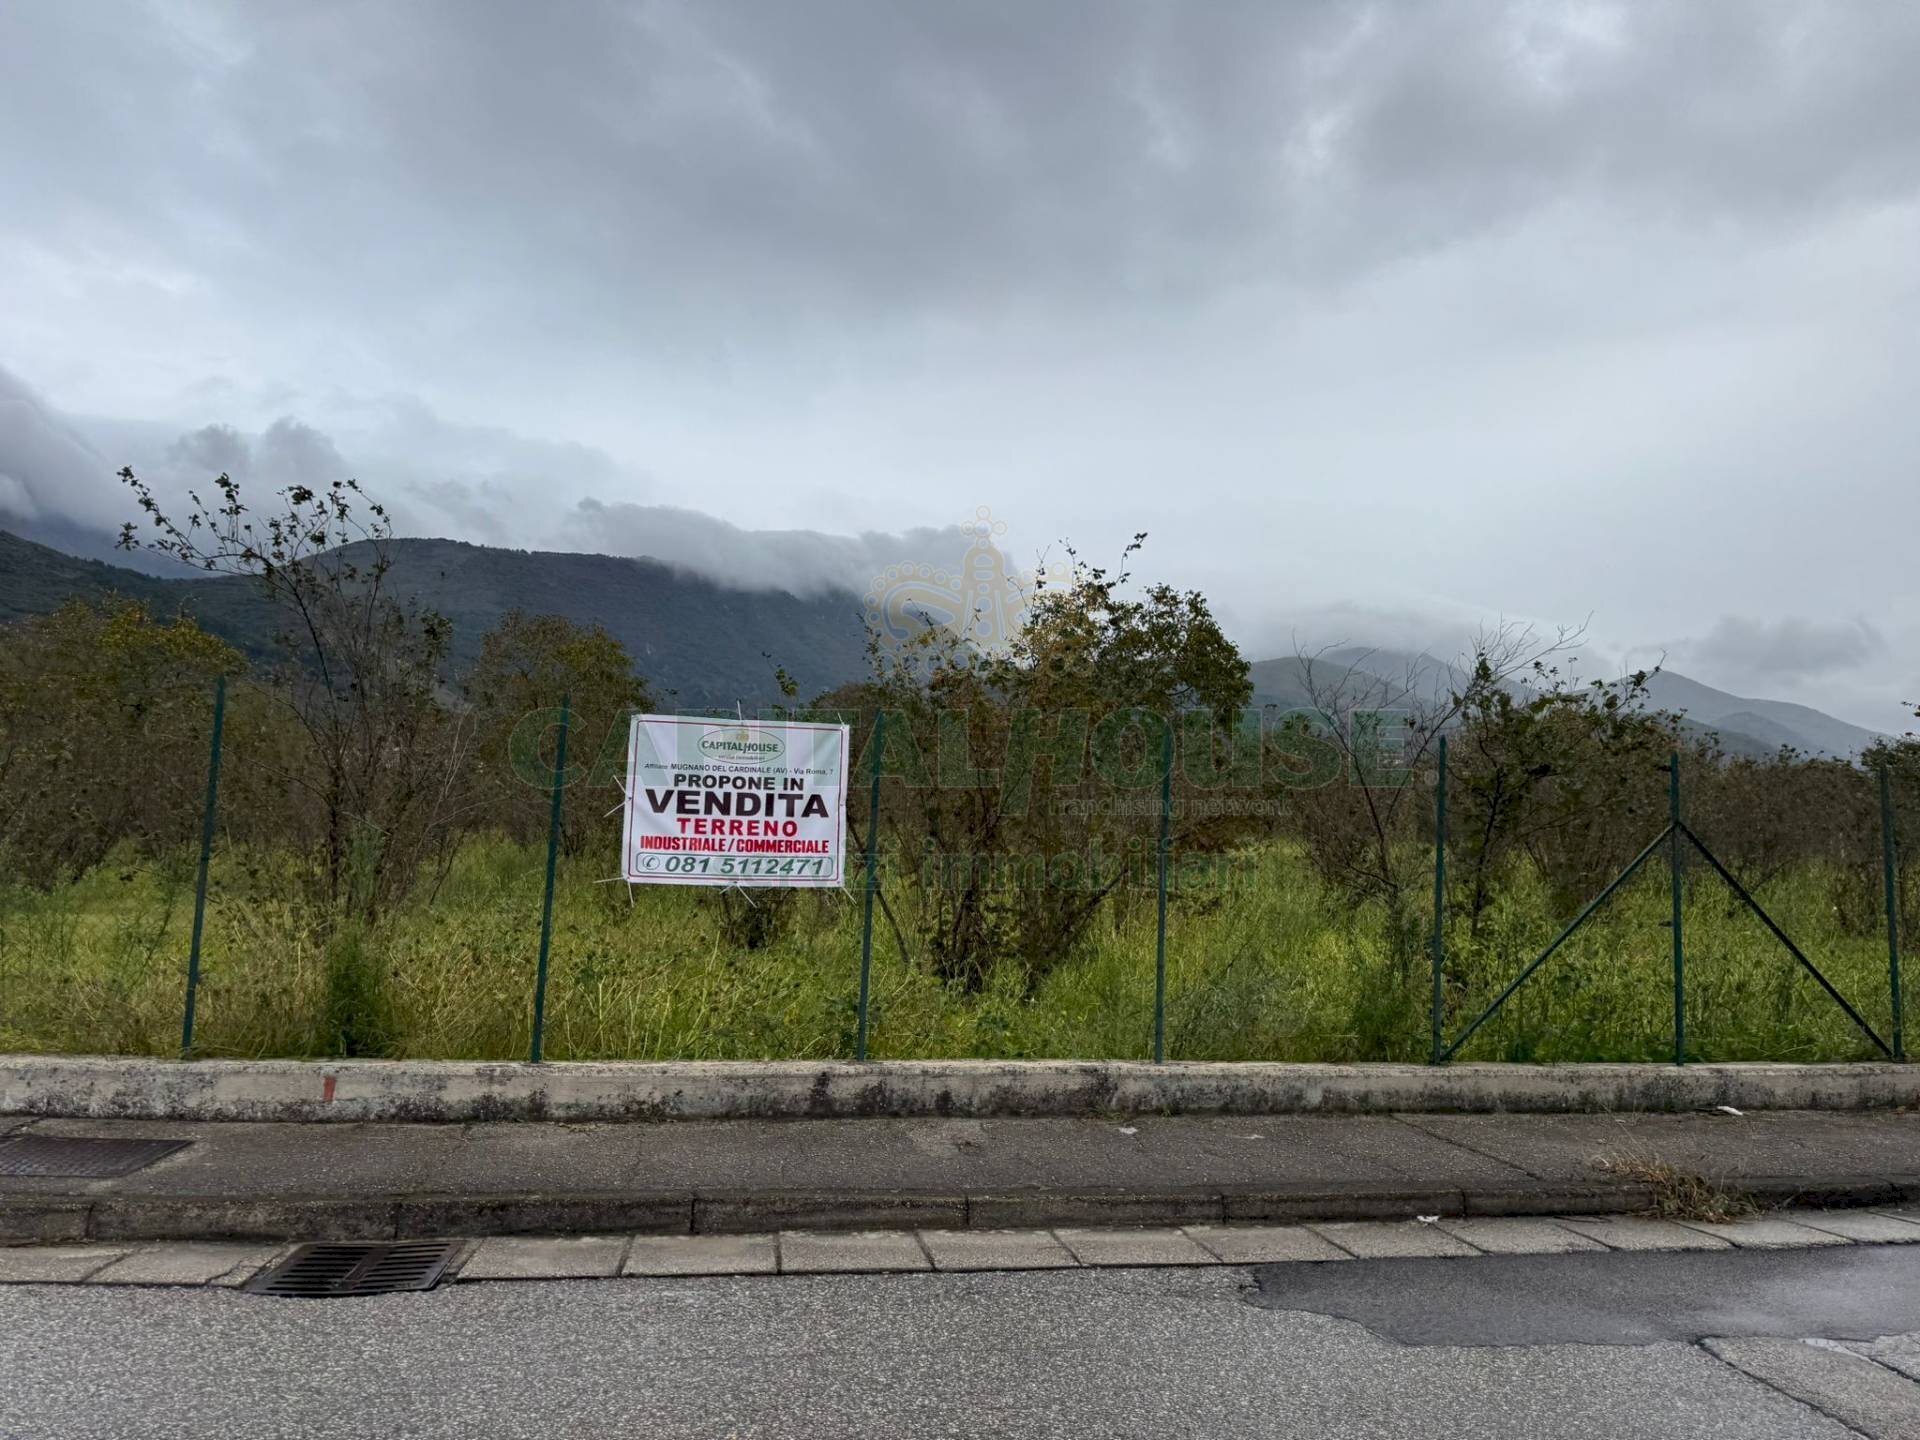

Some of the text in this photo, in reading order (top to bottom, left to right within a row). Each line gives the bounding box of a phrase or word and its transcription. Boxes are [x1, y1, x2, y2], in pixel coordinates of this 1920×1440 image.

[702, 740, 778, 753] CAPITALHOUSE
[671, 763, 710, 772] MUGNANO
[729, 766, 771, 774] CARDINALE
[773, 767, 788, 776] (AV)
[794, 767, 804, 775] Via
[674, 773, 804, 791] PROPONE IN
[645, 789, 829, 818] VENDITA
[677, 818, 798, 837] TERRENO
[640, 836, 726, 852] INDUSTRIALE
[736, 839, 829, 854] COMMERCIALE
[665, 856, 824, 875] 081 5112471
